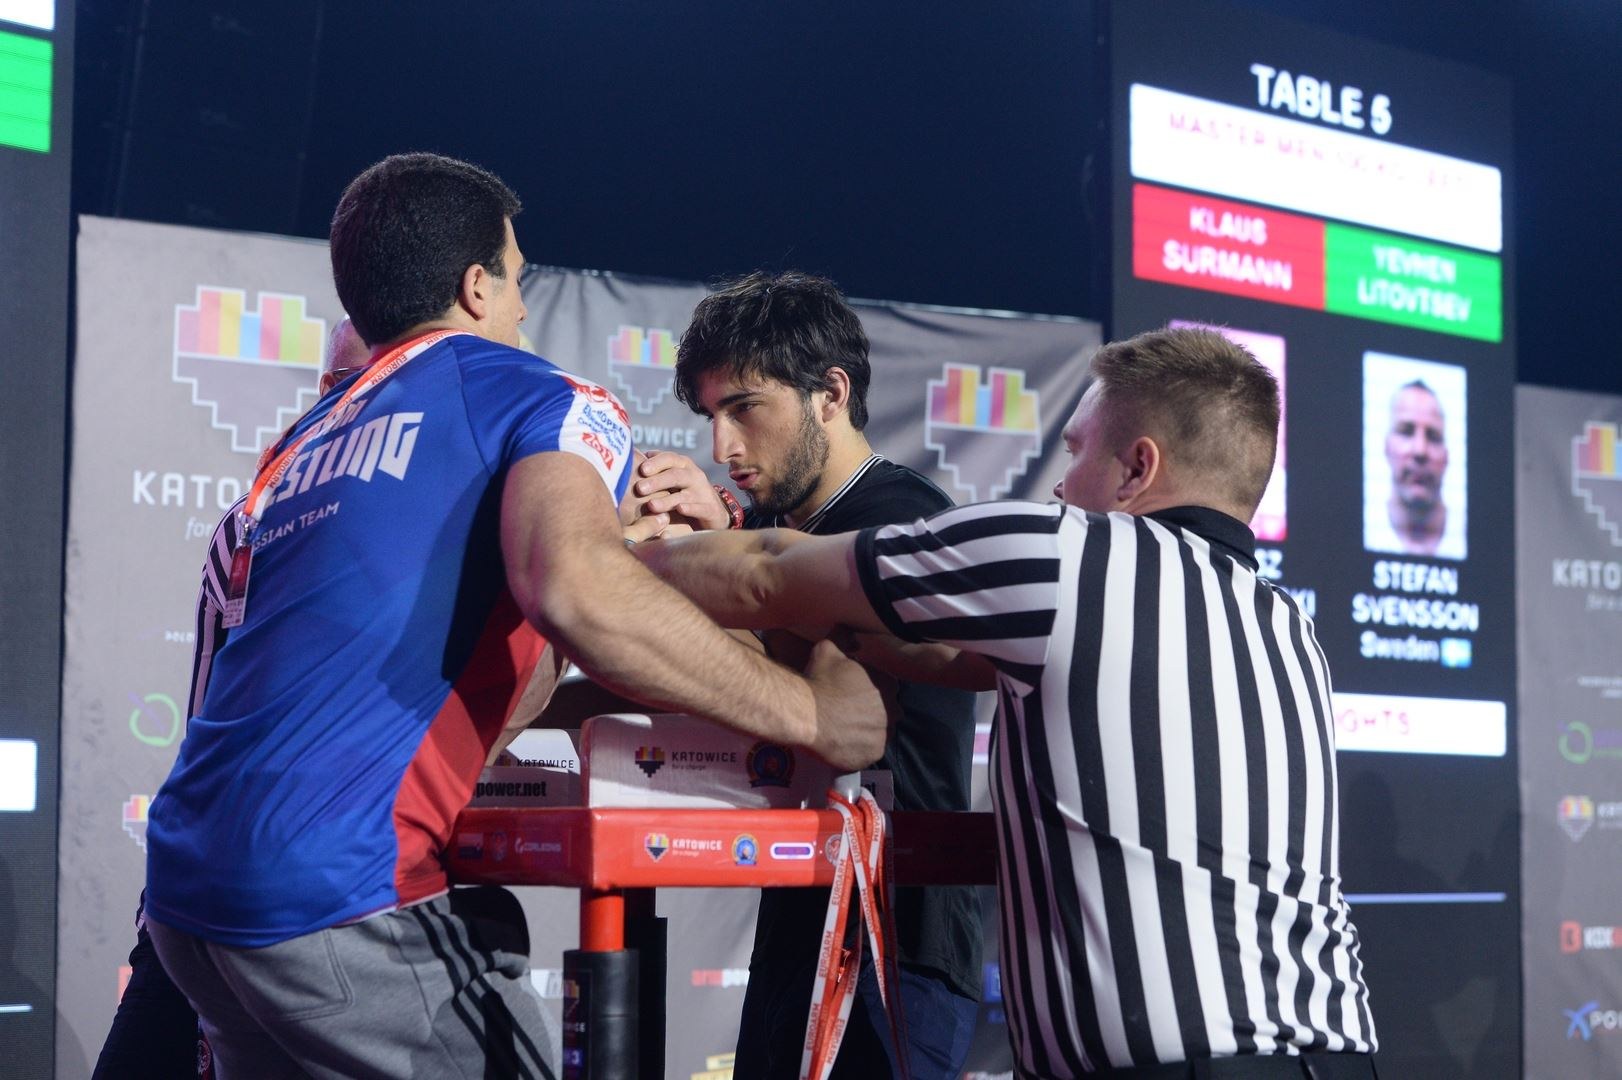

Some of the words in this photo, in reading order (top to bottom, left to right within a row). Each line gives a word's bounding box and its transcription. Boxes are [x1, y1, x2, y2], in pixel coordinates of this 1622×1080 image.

[1250, 63, 1364, 130] TABLE
[1370, 94, 1393, 135] 5
[1189, 206, 1268, 246] KLAUS
[1162, 239, 1293, 292] SURMANN
[371, 353, 408, 385] EUROARM
[132, 469, 252, 510] KATO
[299, 501, 340, 530] TEAM
[1373, 559, 1458, 596] STEFAN
[1352, 592, 1480, 632] SVENSSON
[1360, 630, 1440, 662] Sweden
[516, 759, 575, 769] KATOWICE
[671, 751, 737, 763] KATOWICE
[474, 781, 547, 798] power.net
[672, 838, 723, 851] KATOWICE
[831, 858, 847, 906] EUROARM
[818, 930, 834, 978] EUROARM
[806, 1002, 821, 1051] EUROARM
[827, 1018, 846, 1065] EUROARM
